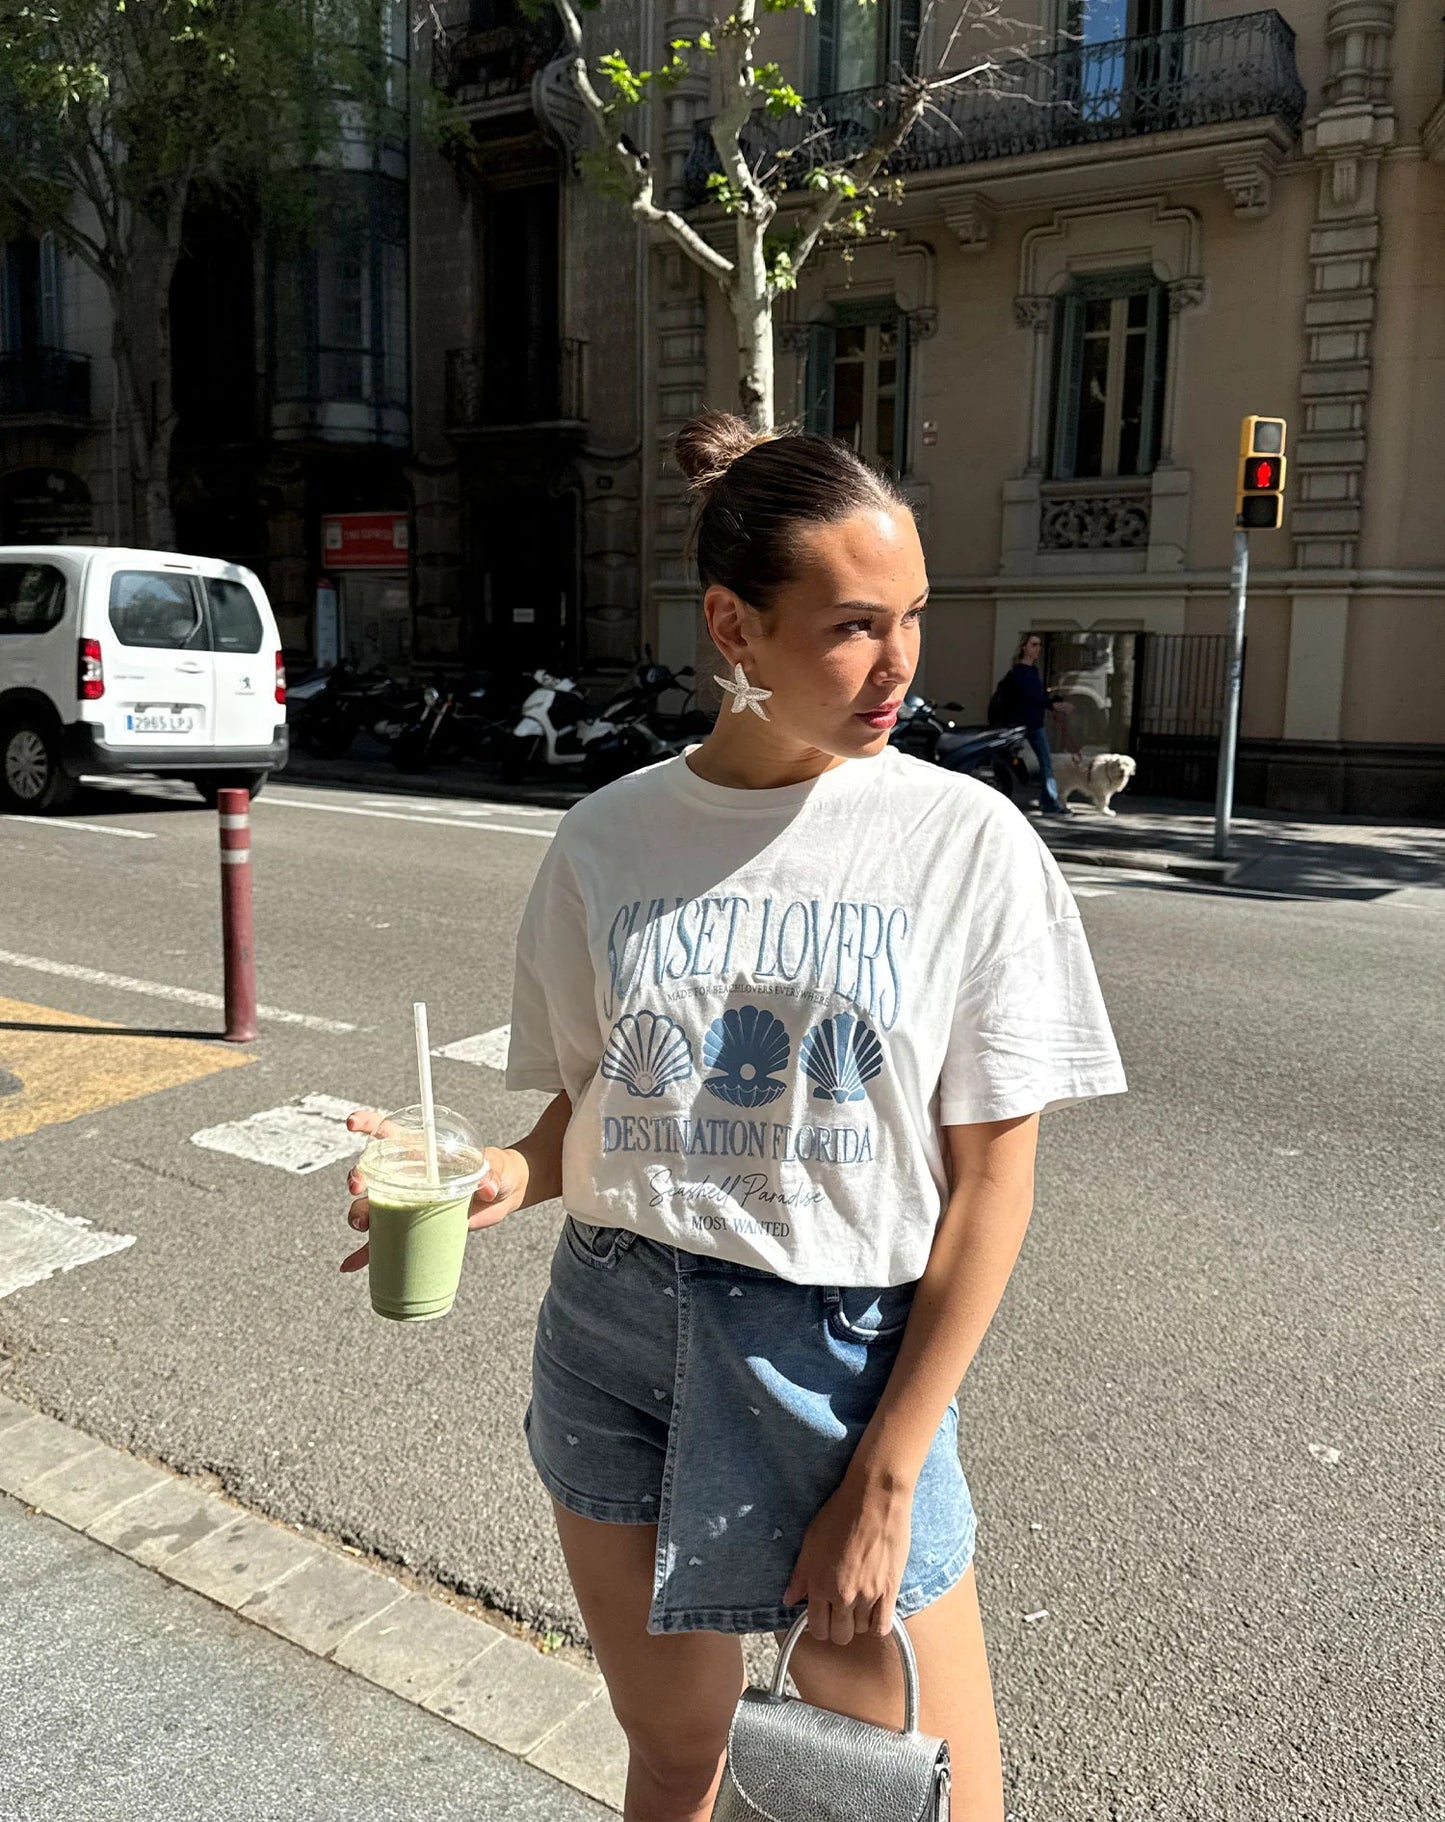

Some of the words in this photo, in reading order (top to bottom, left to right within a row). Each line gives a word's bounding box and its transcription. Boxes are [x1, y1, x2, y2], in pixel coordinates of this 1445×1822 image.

[604, 896, 750, 1020] SUNSET
[752, 897, 908, 1030] LOVERS
[667, 989, 693, 1002] MADE
[694, 986, 711, 998] FOR
[603, 1115, 767, 1159] DESTINATION
[771, 1124, 875, 1164] FLORIDA
[649, 1168, 740, 1208] Seashell
[740, 1172, 826, 1209] Paradise
[691, 1215, 728, 1231] MOST
[732, 1217, 790, 1238] WANTED
